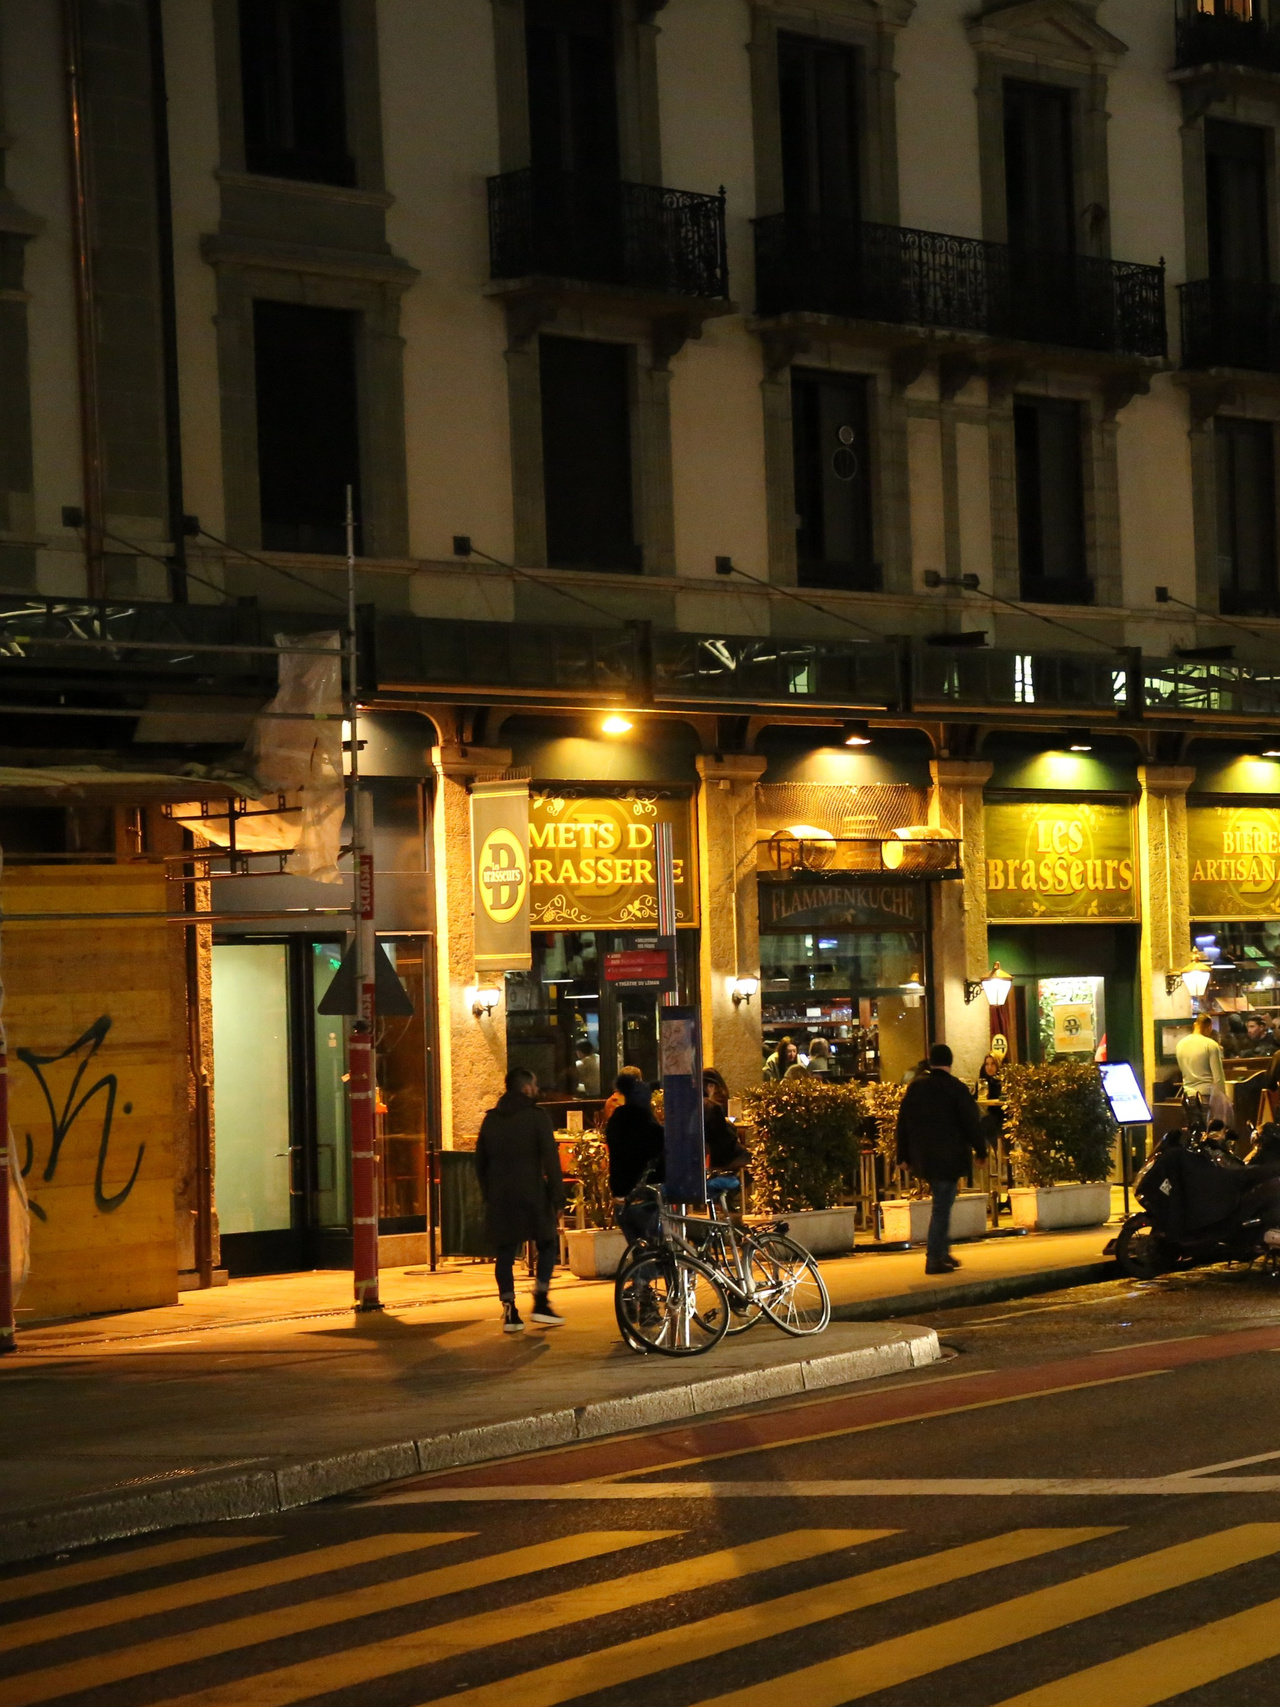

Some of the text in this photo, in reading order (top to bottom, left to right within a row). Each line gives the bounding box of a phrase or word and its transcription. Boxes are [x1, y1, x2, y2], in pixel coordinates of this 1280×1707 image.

[529, 823, 656, 849] METS D
[1037, 820, 1084, 854] Les
[529, 858, 684, 885] RASSERE
[987, 858, 1133, 891] Brasseurs
[772, 886, 915, 922] FLAMMENKUCHE
